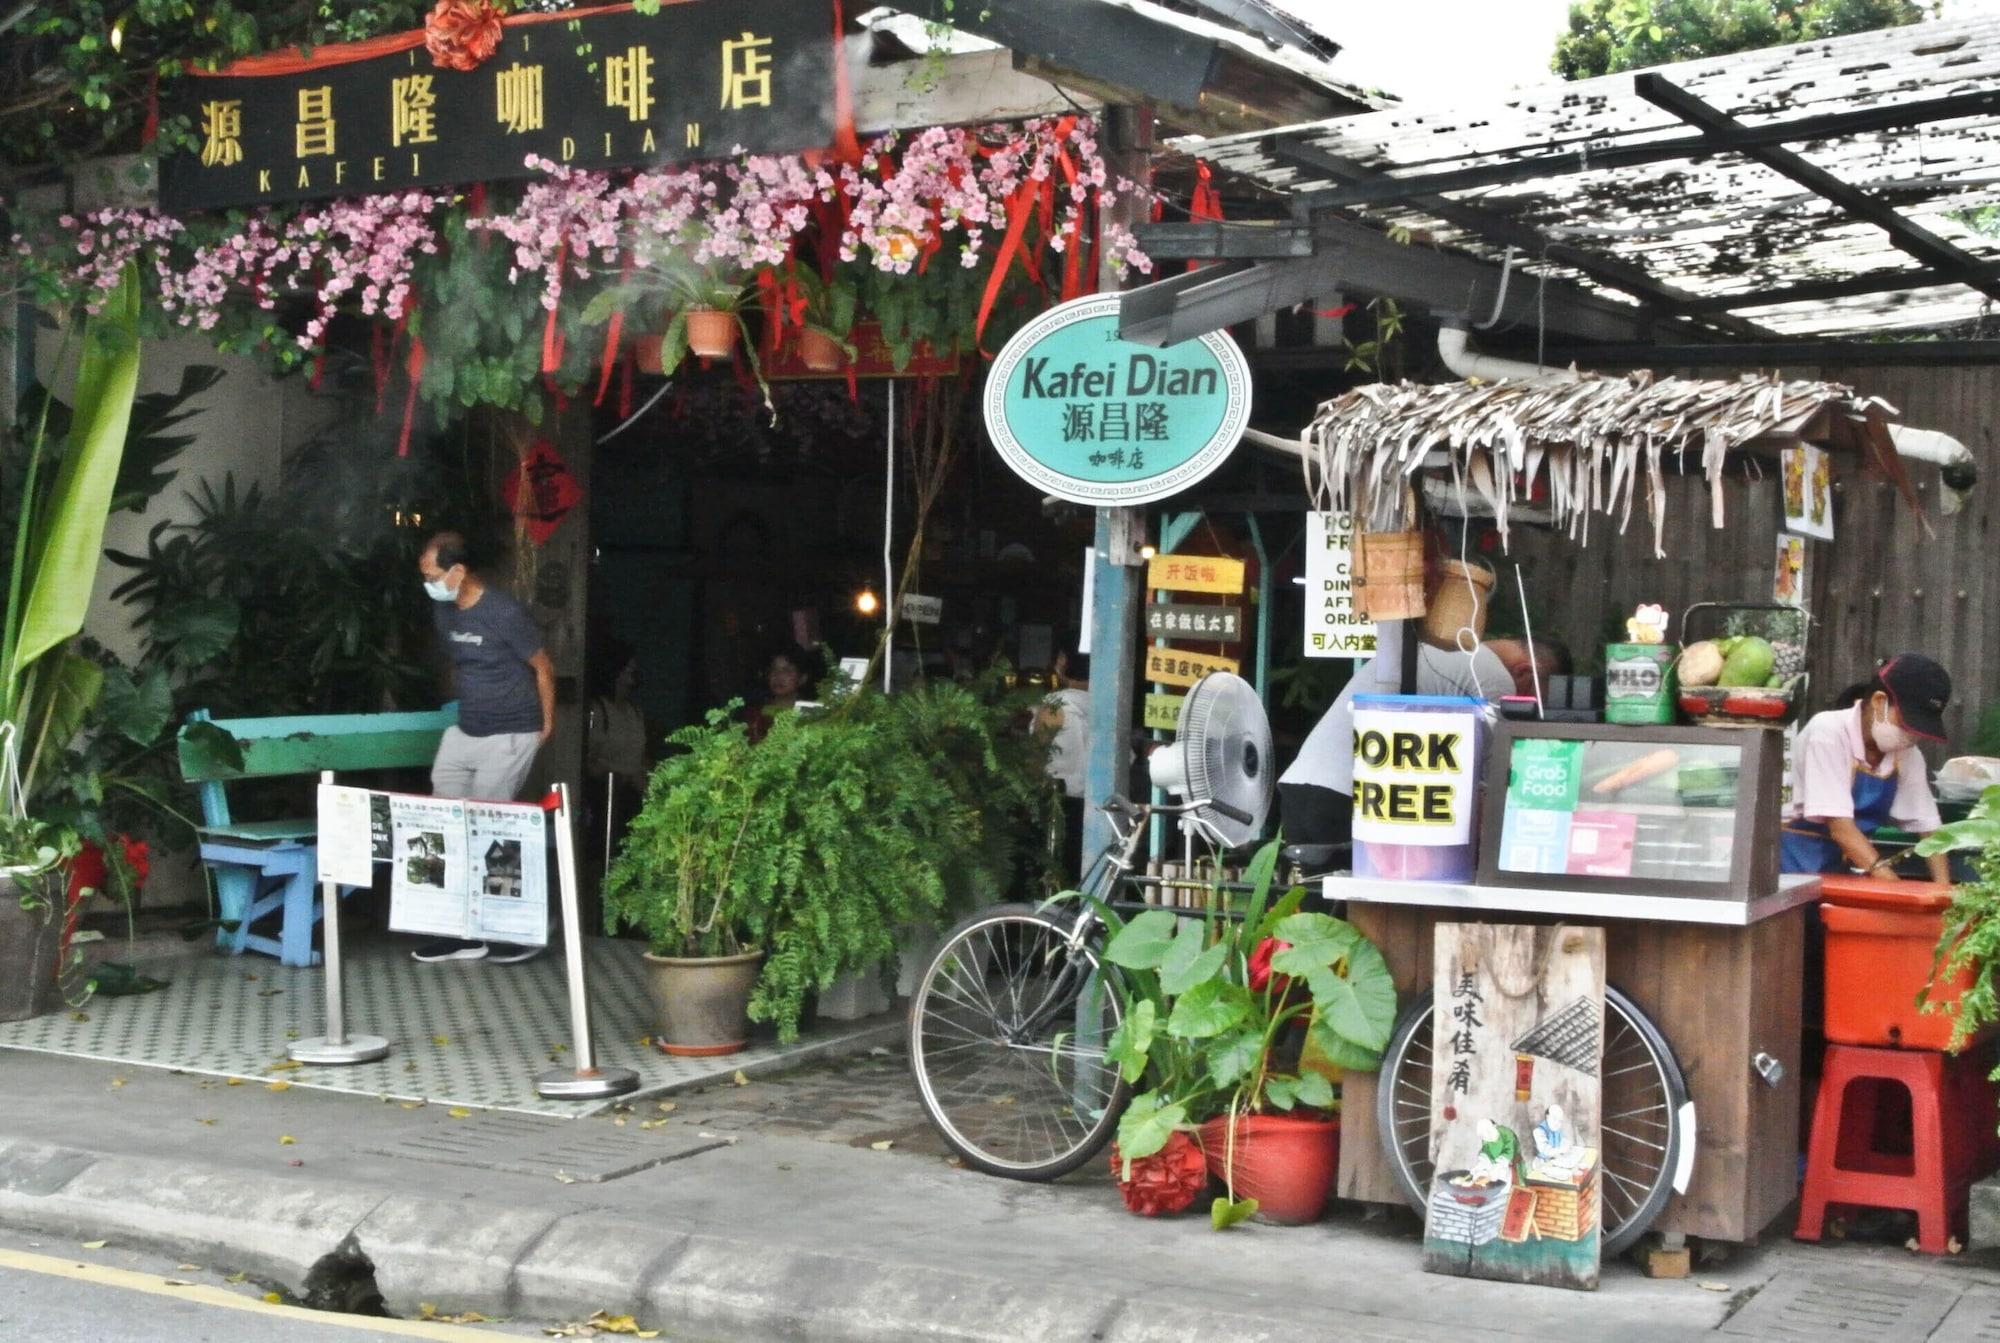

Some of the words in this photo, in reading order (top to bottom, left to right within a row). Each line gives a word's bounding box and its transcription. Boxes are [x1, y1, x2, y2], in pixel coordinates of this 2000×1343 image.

[202, 32, 773, 168] 源昌隆咖啡店
[259, 153, 421, 192] KAFEI
[562, 123, 700, 161] DIAN
[1022, 357, 1116, 399] Kafei
[1126, 353, 1217, 396] Dian
[1061, 402, 1169, 442] 源昌隆
[1088, 447, 1145, 470] 咖啡店
[1608, 669, 1658, 686] MILO
[1522, 781, 1568, 797] Food
[1527, 764, 1568, 780] Grab
[1447, 973, 1484, 1095] 美味佳肴
